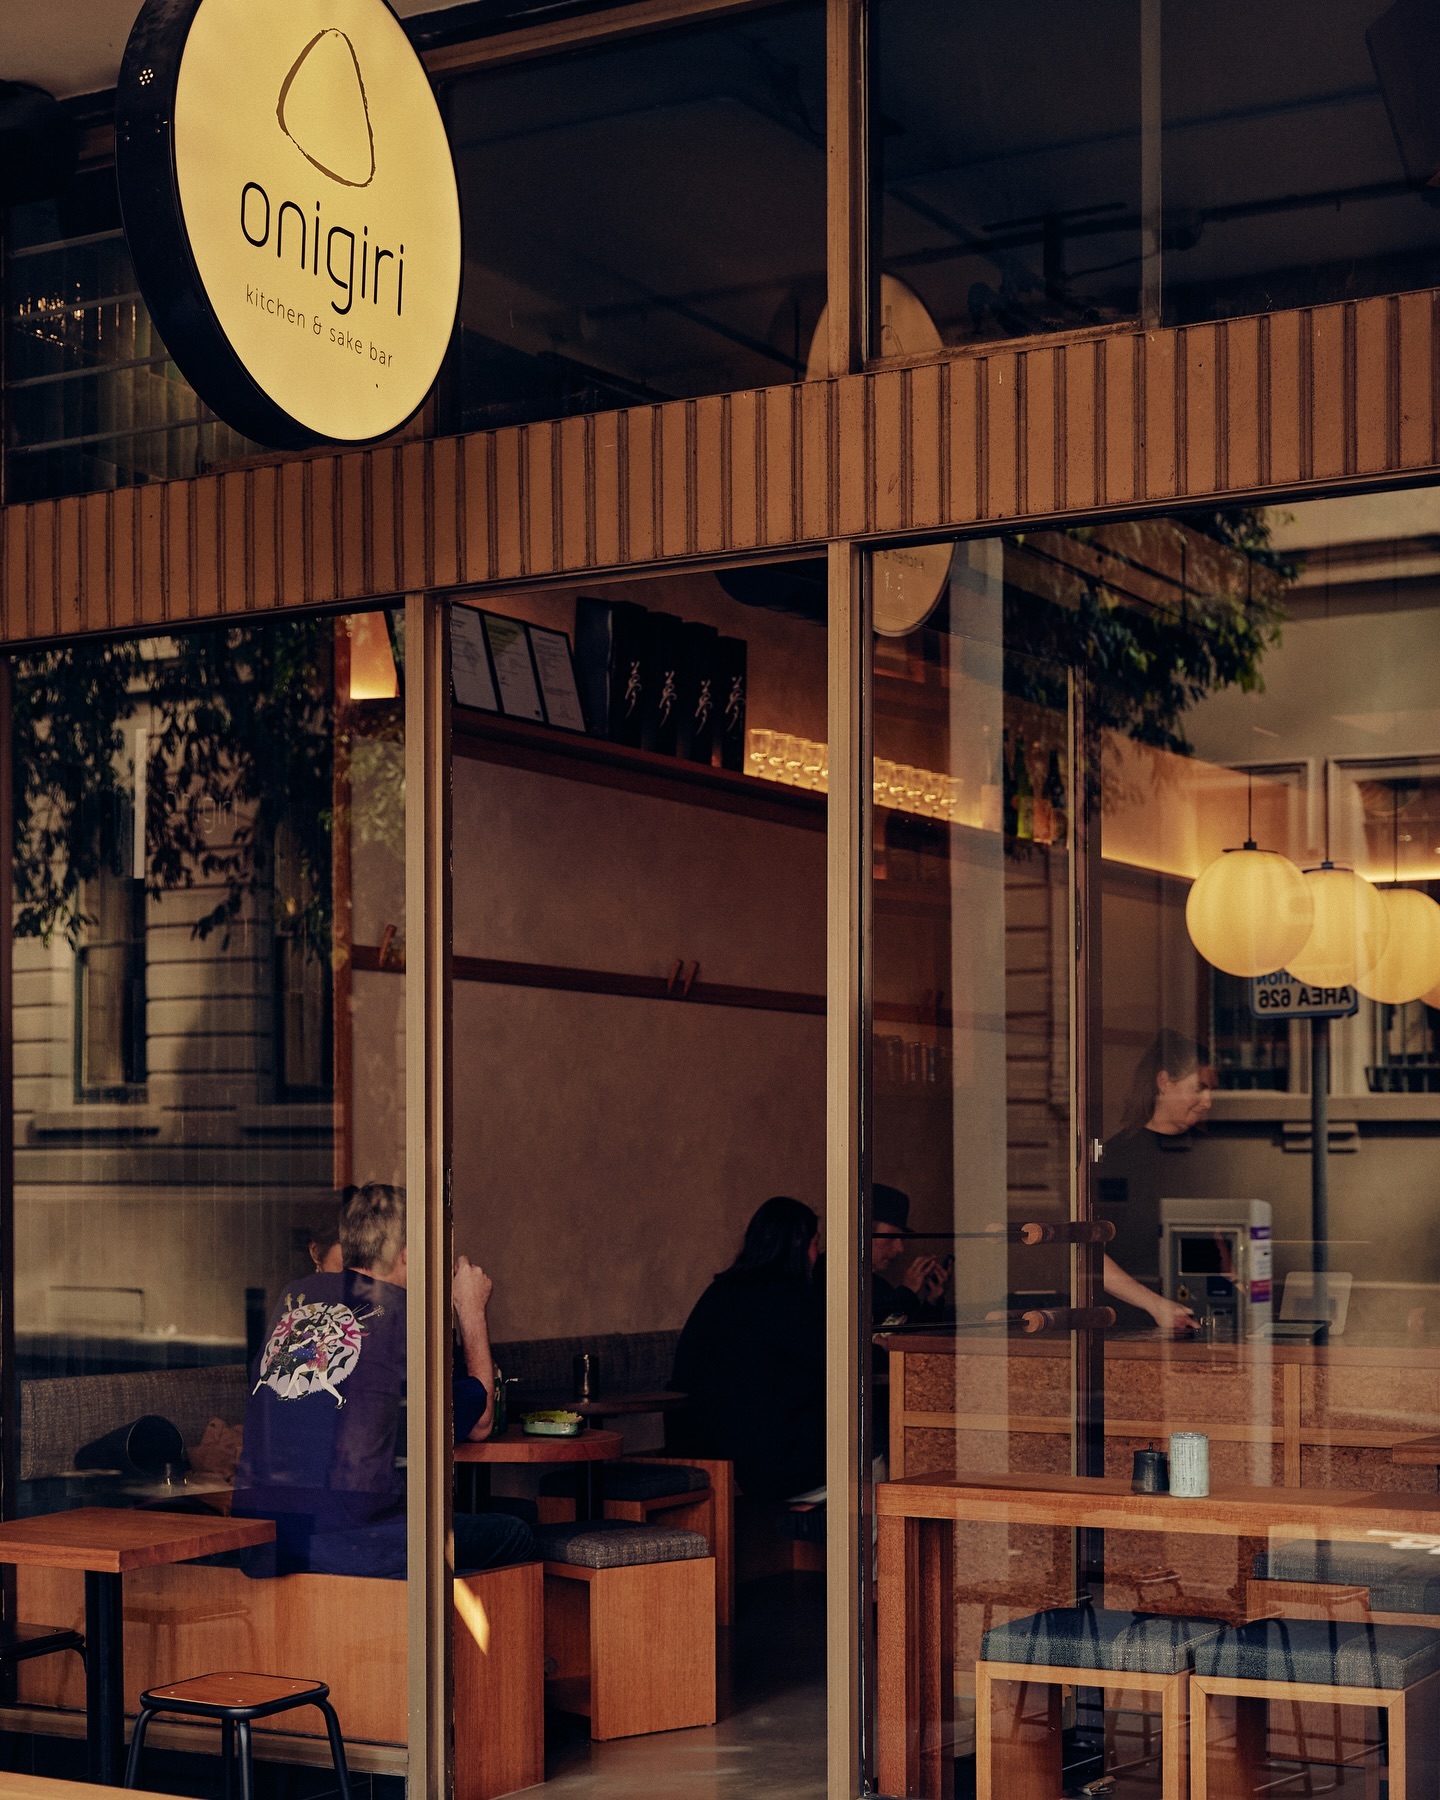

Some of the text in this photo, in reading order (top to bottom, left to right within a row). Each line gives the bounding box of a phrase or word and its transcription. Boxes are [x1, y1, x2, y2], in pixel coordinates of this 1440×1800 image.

[241, 181, 404, 316] onigiri
[246, 283, 393, 367] kitchen & sake bar
